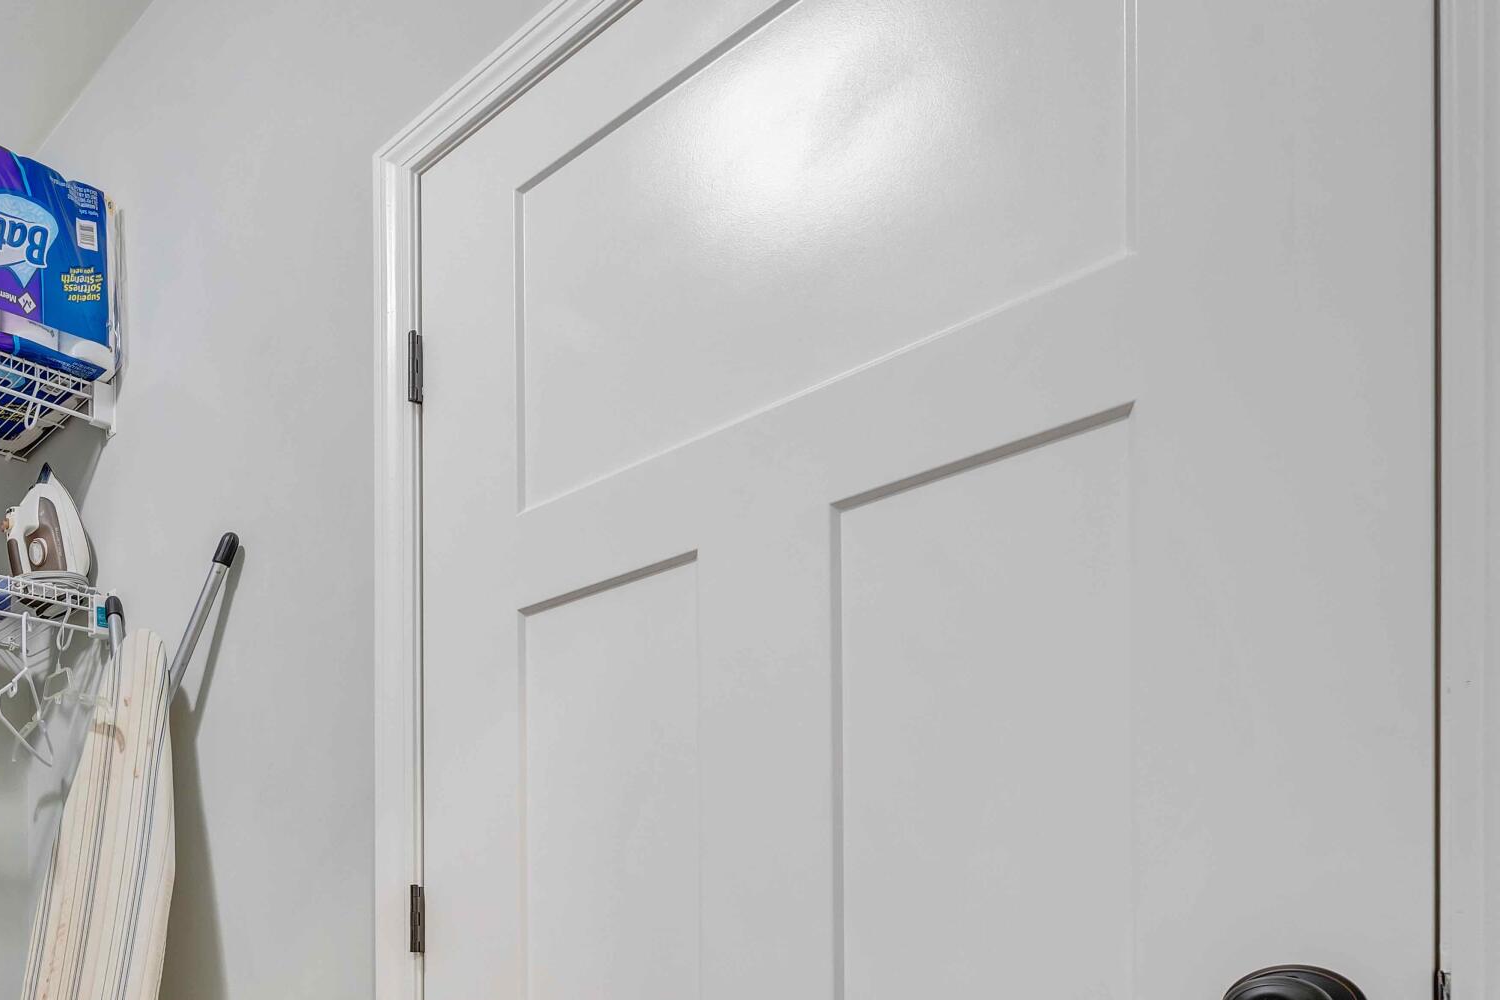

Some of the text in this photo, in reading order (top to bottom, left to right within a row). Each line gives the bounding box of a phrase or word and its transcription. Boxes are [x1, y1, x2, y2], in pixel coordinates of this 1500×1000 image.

[61, 273, 94, 284] Strength
[63, 281, 101, 293] Softness
[68, 293, 100, 302] Superior
